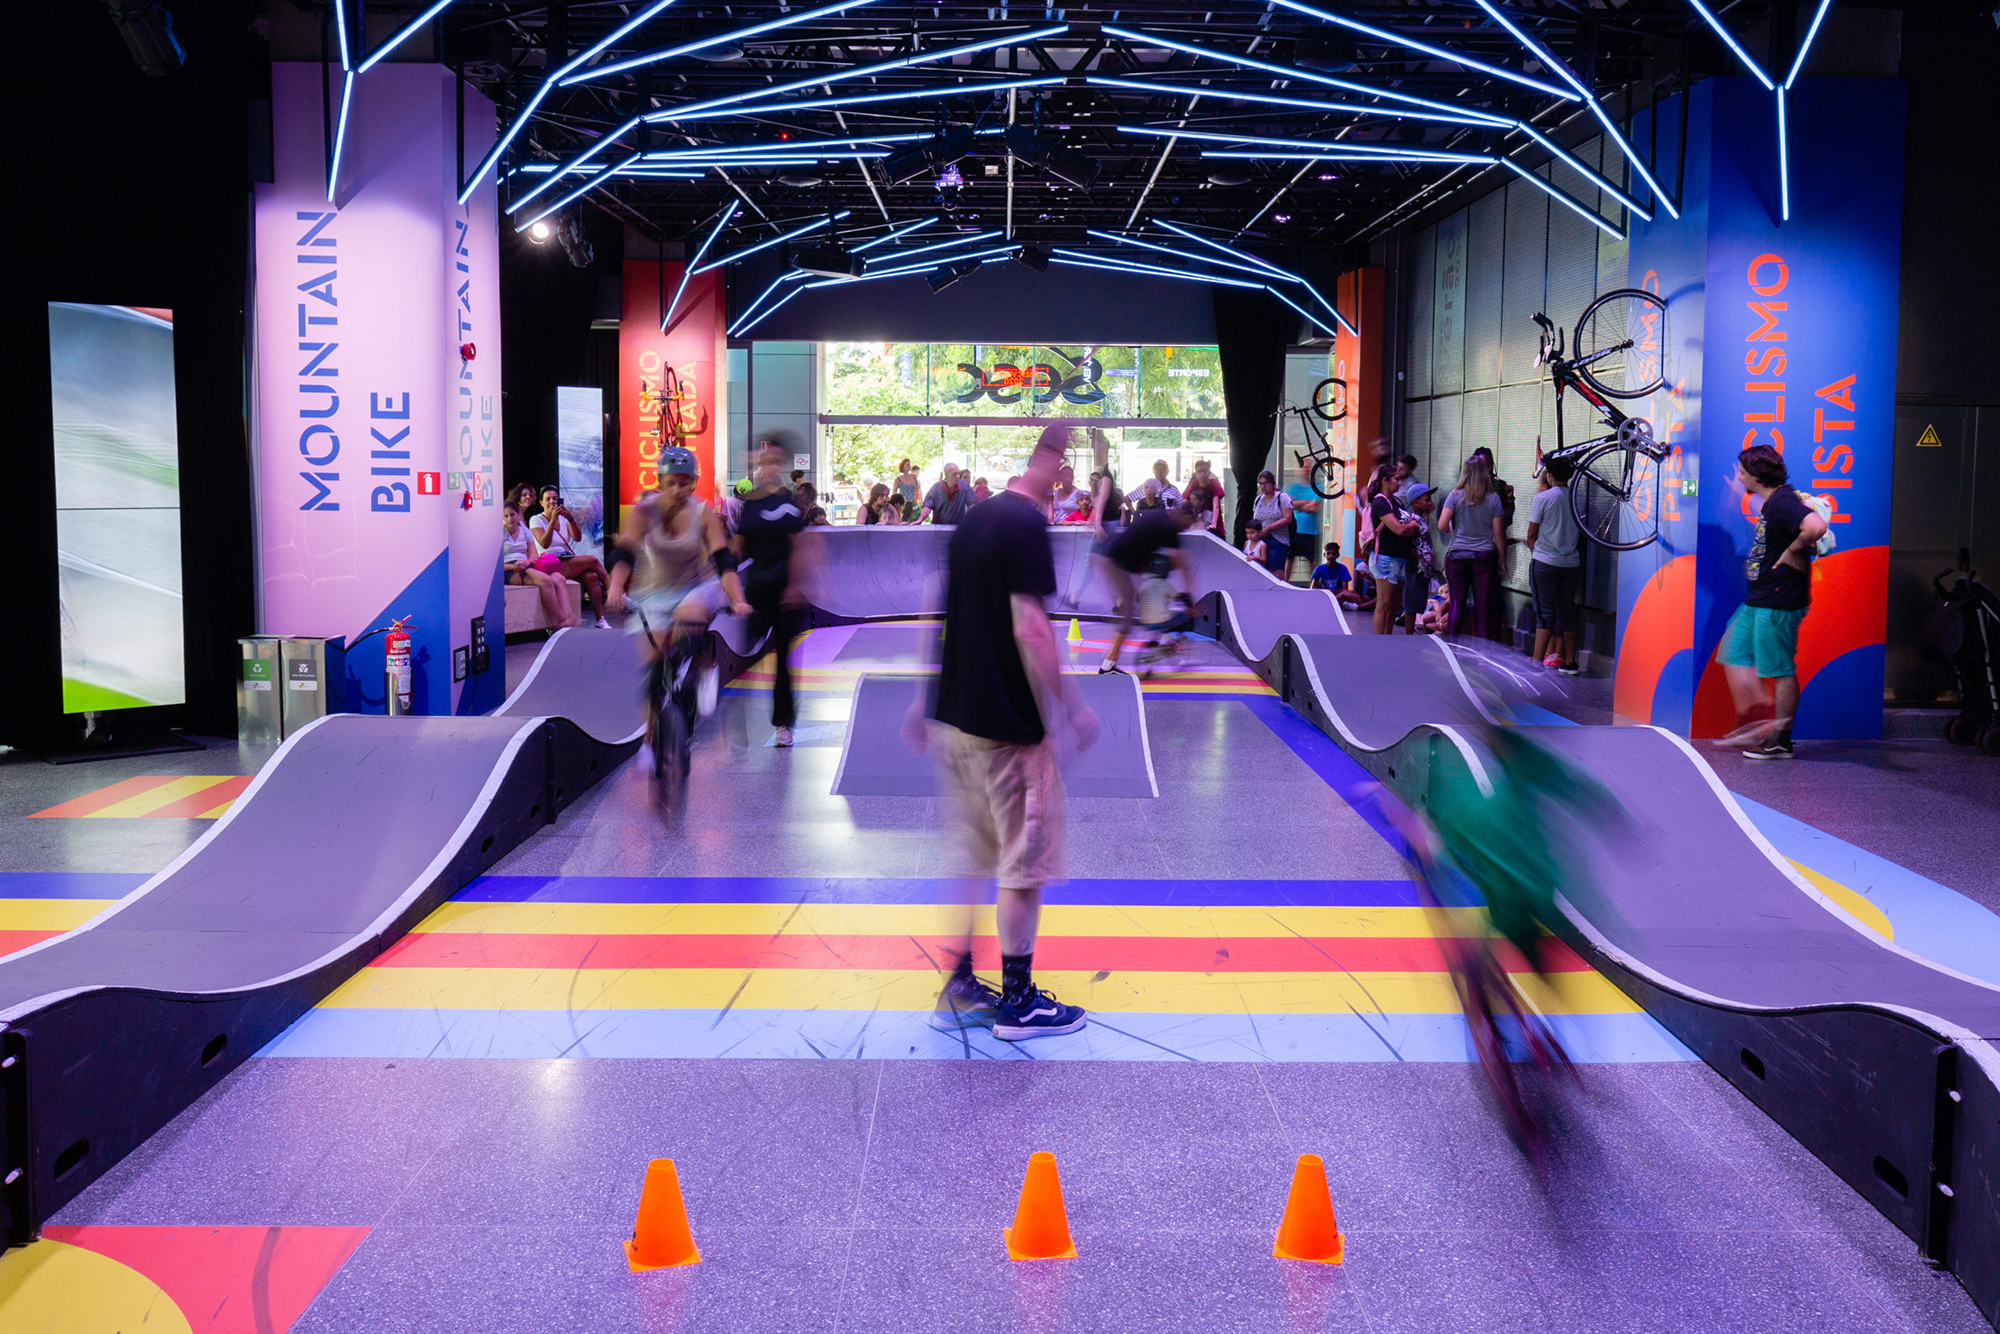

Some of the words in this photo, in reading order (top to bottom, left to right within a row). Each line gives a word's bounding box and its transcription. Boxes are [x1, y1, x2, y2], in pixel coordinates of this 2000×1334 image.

[296, 211, 340, 511] MOUNTAIN
[1571, 348, 1613, 368] LOOK
[370, 391, 411, 513] BIKE
[480, 395, 494, 507] BIKE
[1551, 437, 1608, 459] LOOK
[1662, 378, 1686, 521] PISTA
